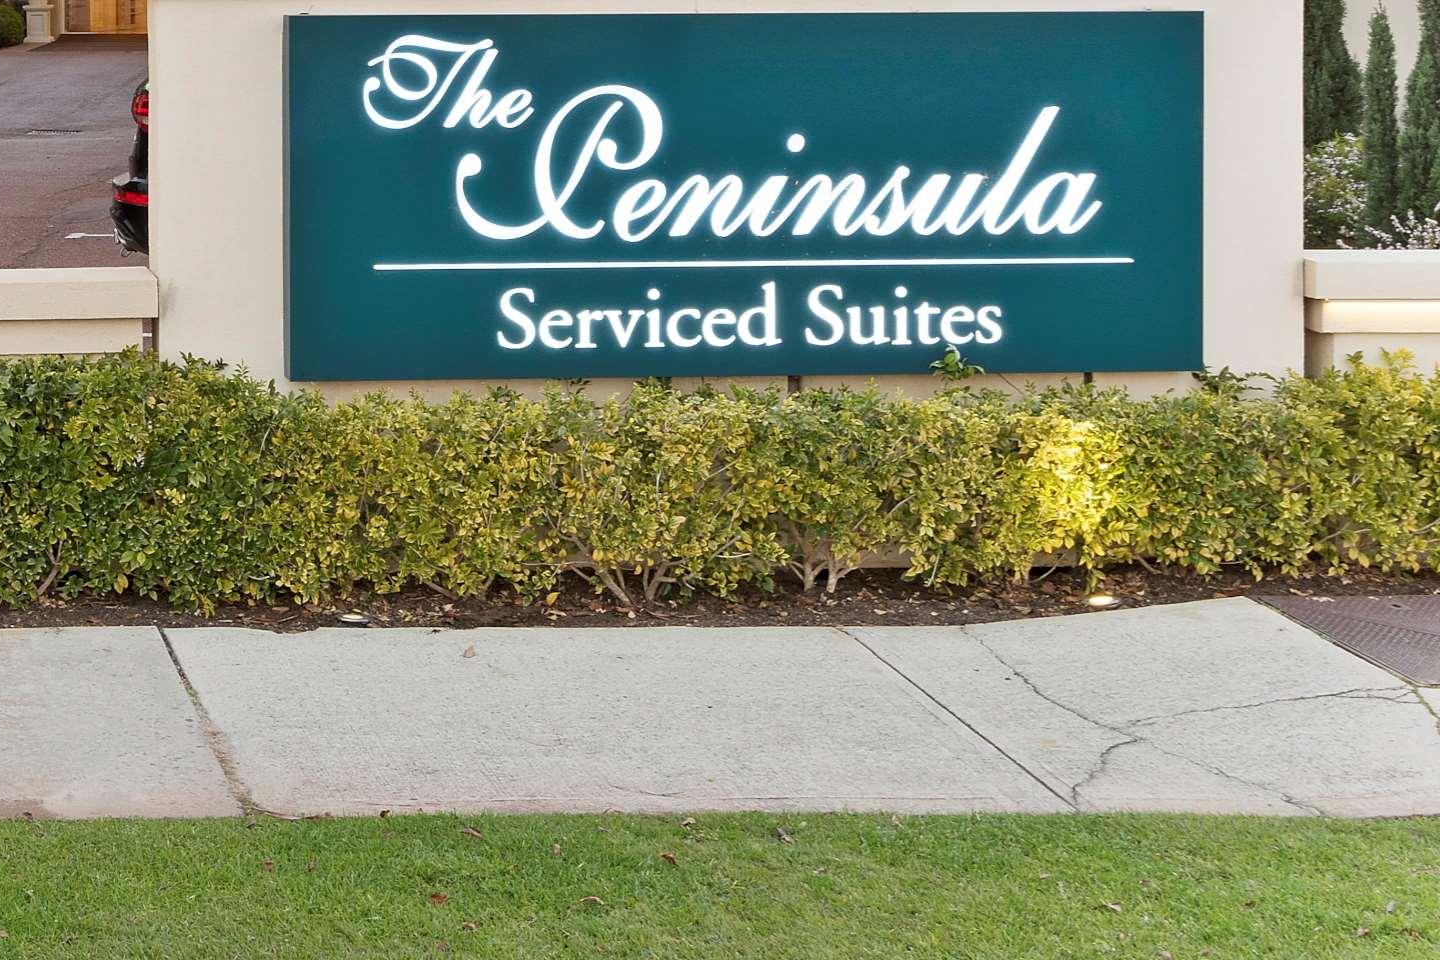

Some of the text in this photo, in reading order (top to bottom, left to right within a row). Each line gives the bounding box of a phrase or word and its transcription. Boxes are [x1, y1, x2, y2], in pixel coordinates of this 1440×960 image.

[363, 35, 535, 130] The
[455, 84, 1103, 243] Peninsula
[496, 280, 1003, 350] Serviced Suites
